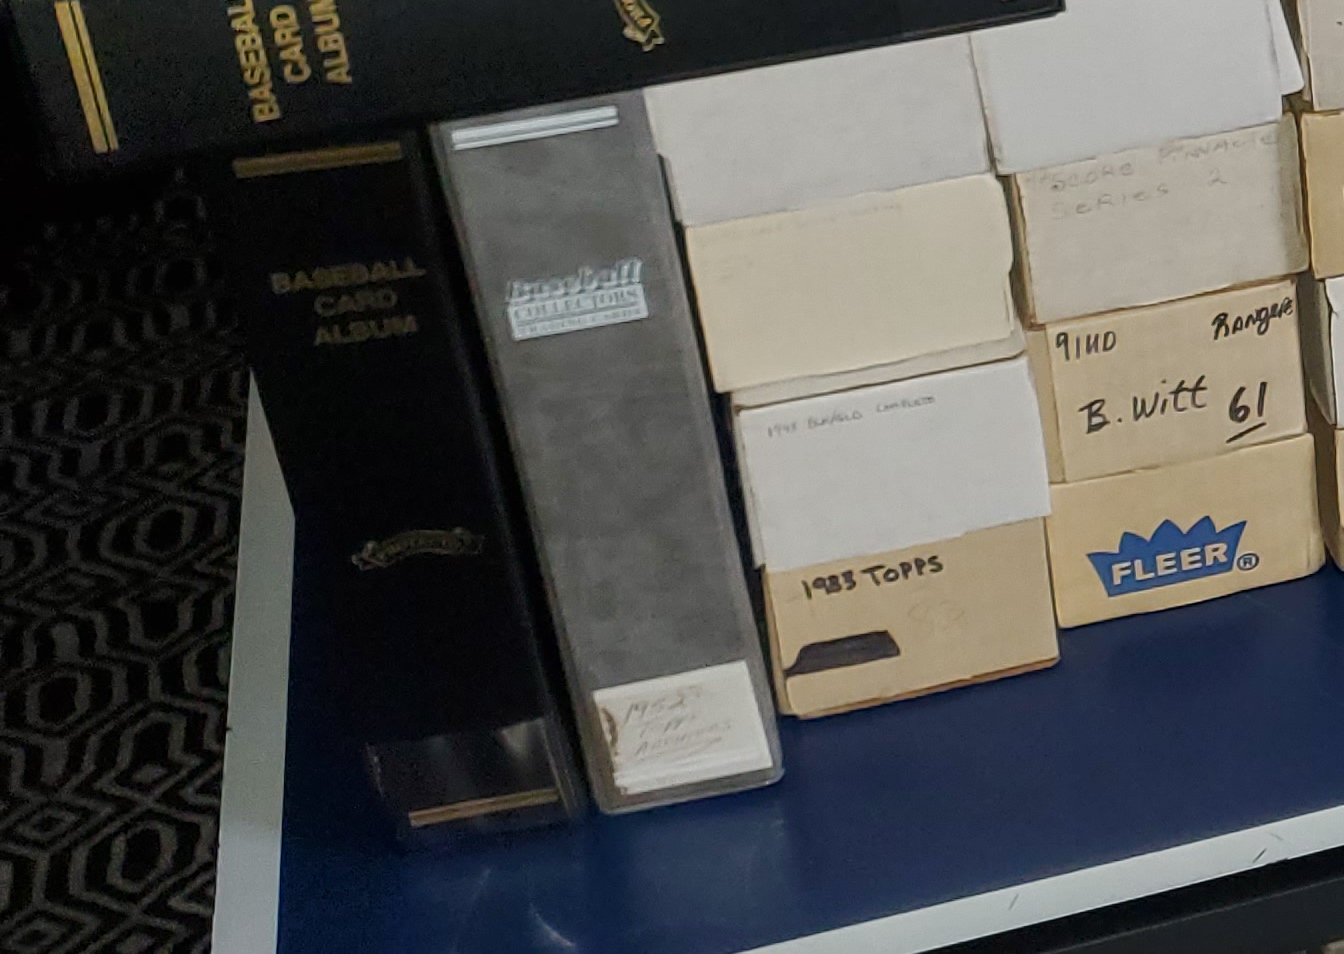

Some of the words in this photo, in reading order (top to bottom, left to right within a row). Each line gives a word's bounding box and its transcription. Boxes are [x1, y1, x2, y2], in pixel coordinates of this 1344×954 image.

[269, 3, 312, 85] CARD
[271, 255, 427, 295] BASEBALL
[314, 288, 398, 317] CARD
[314, 313, 418, 346] ALBUM
[1228, 381, 1268, 425] 61
[801, 569, 857, 600] 1983
[860, 554, 944, 587] TOPPS
[1111, 542, 1229, 587] FLEER
